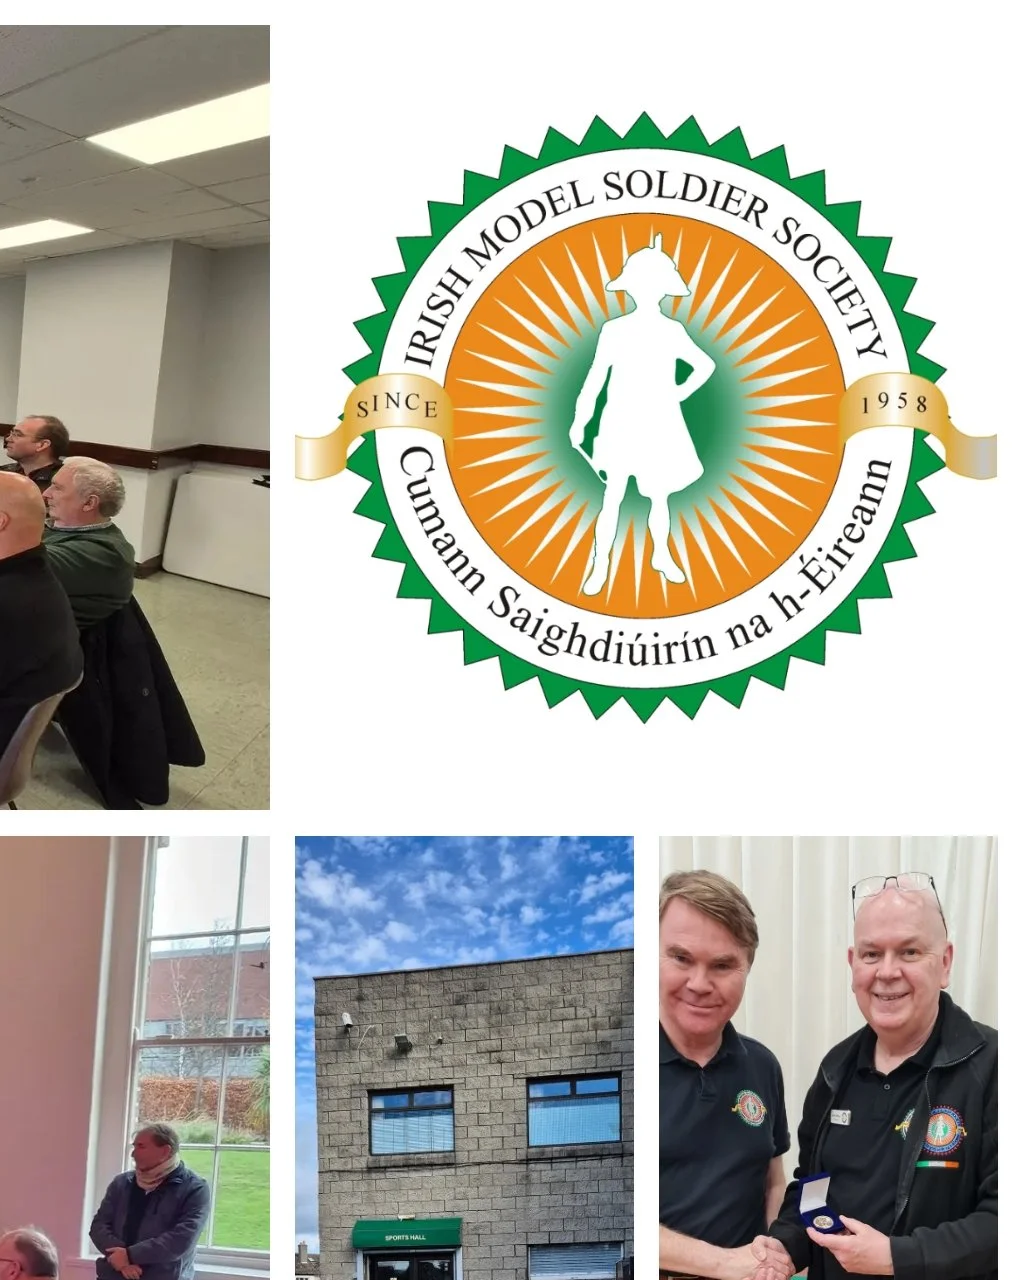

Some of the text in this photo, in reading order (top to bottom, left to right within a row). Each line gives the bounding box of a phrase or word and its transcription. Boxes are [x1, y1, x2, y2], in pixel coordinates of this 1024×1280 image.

[404, 169, 888, 367] IRISH MODEL SOLDIER SOCIETY
[357, 391, 438, 418] SINCE
[862, 391, 928, 414] 1958
[400, 446, 893, 667] Cumann Saighdiúirín na h-Éireann
[384, 1234, 409, 1242] SPORTS
